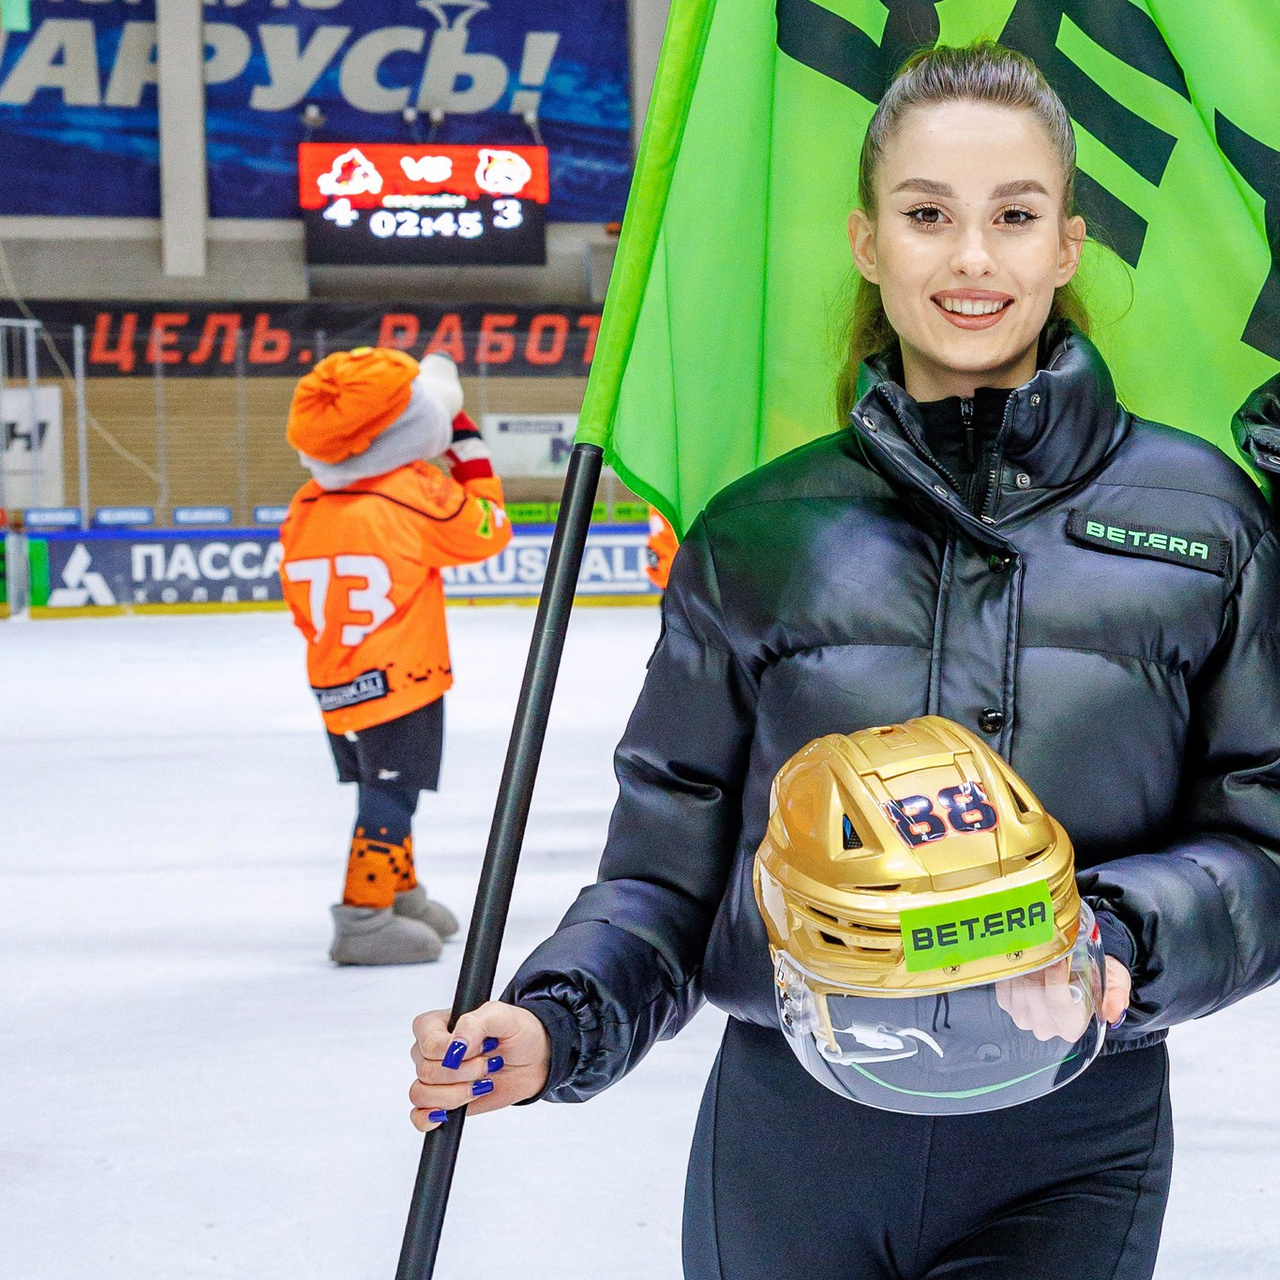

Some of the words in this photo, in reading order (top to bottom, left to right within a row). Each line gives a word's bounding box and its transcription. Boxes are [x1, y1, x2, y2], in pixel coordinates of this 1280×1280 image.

[0, 19, 560, 114] АРУСЬ!
[323, 197, 359, 227] 4
[369, 210, 483, 239] 02:45
[493, 199, 523, 229] 3
[89, 313, 312, 372] ЦЕЛЬ.
[284, 553, 397, 647] 73
[886, 780, 999, 849] 88
